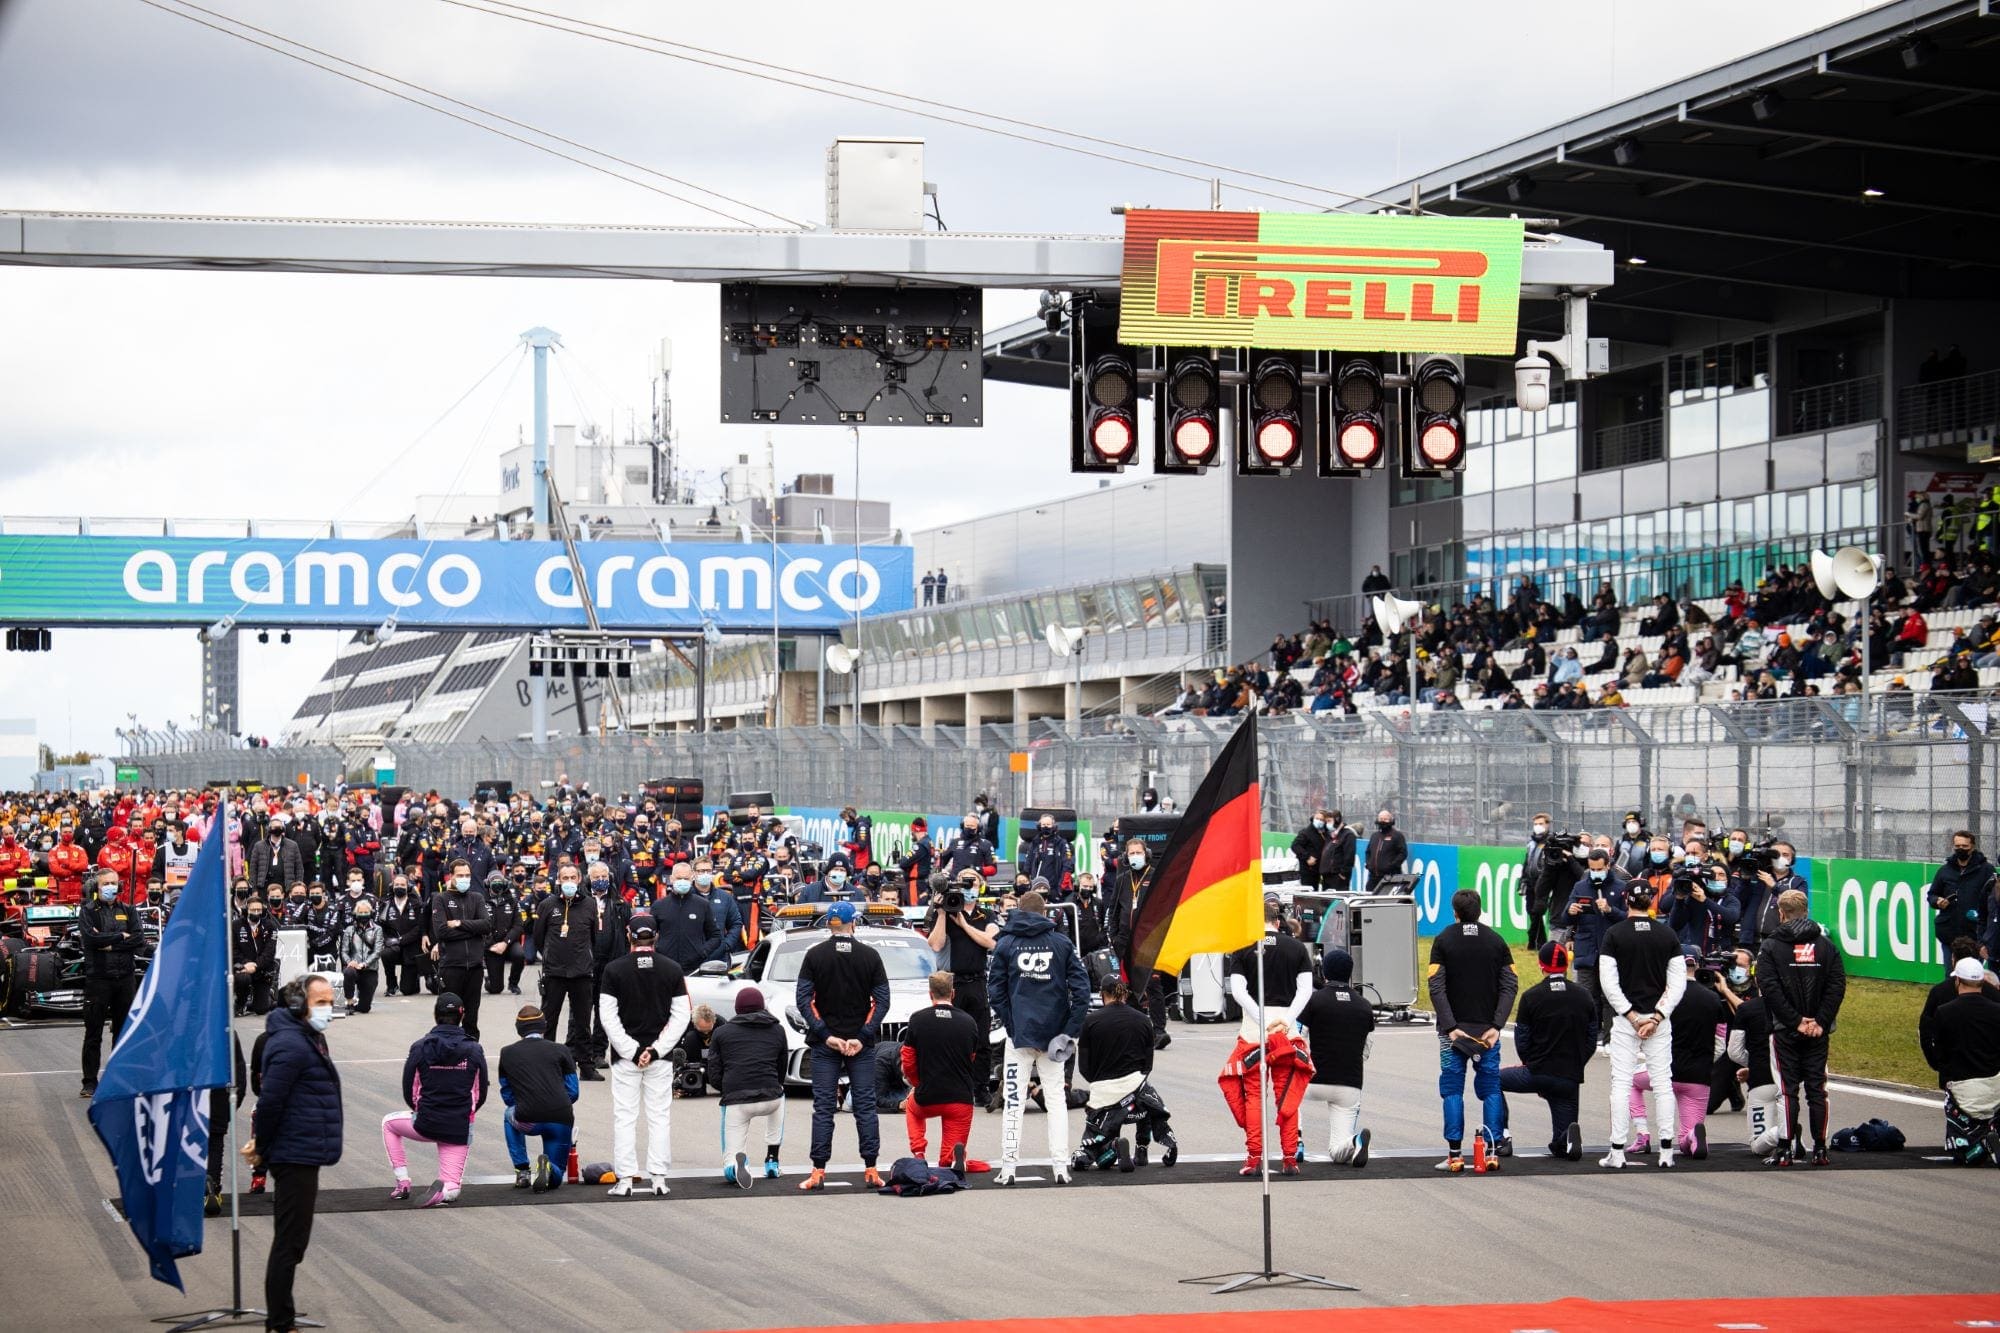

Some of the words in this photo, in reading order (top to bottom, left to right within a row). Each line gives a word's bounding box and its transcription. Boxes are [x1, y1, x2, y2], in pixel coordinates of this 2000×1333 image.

[1155, 238, 1488, 323] PIRELLI
[122, 549, 482, 608] aramco
[534, 554, 881, 611] aramco
[1148, 833, 1168, 841] FRONT
[1005, 1062, 1019, 1163] ALPHATAURI
